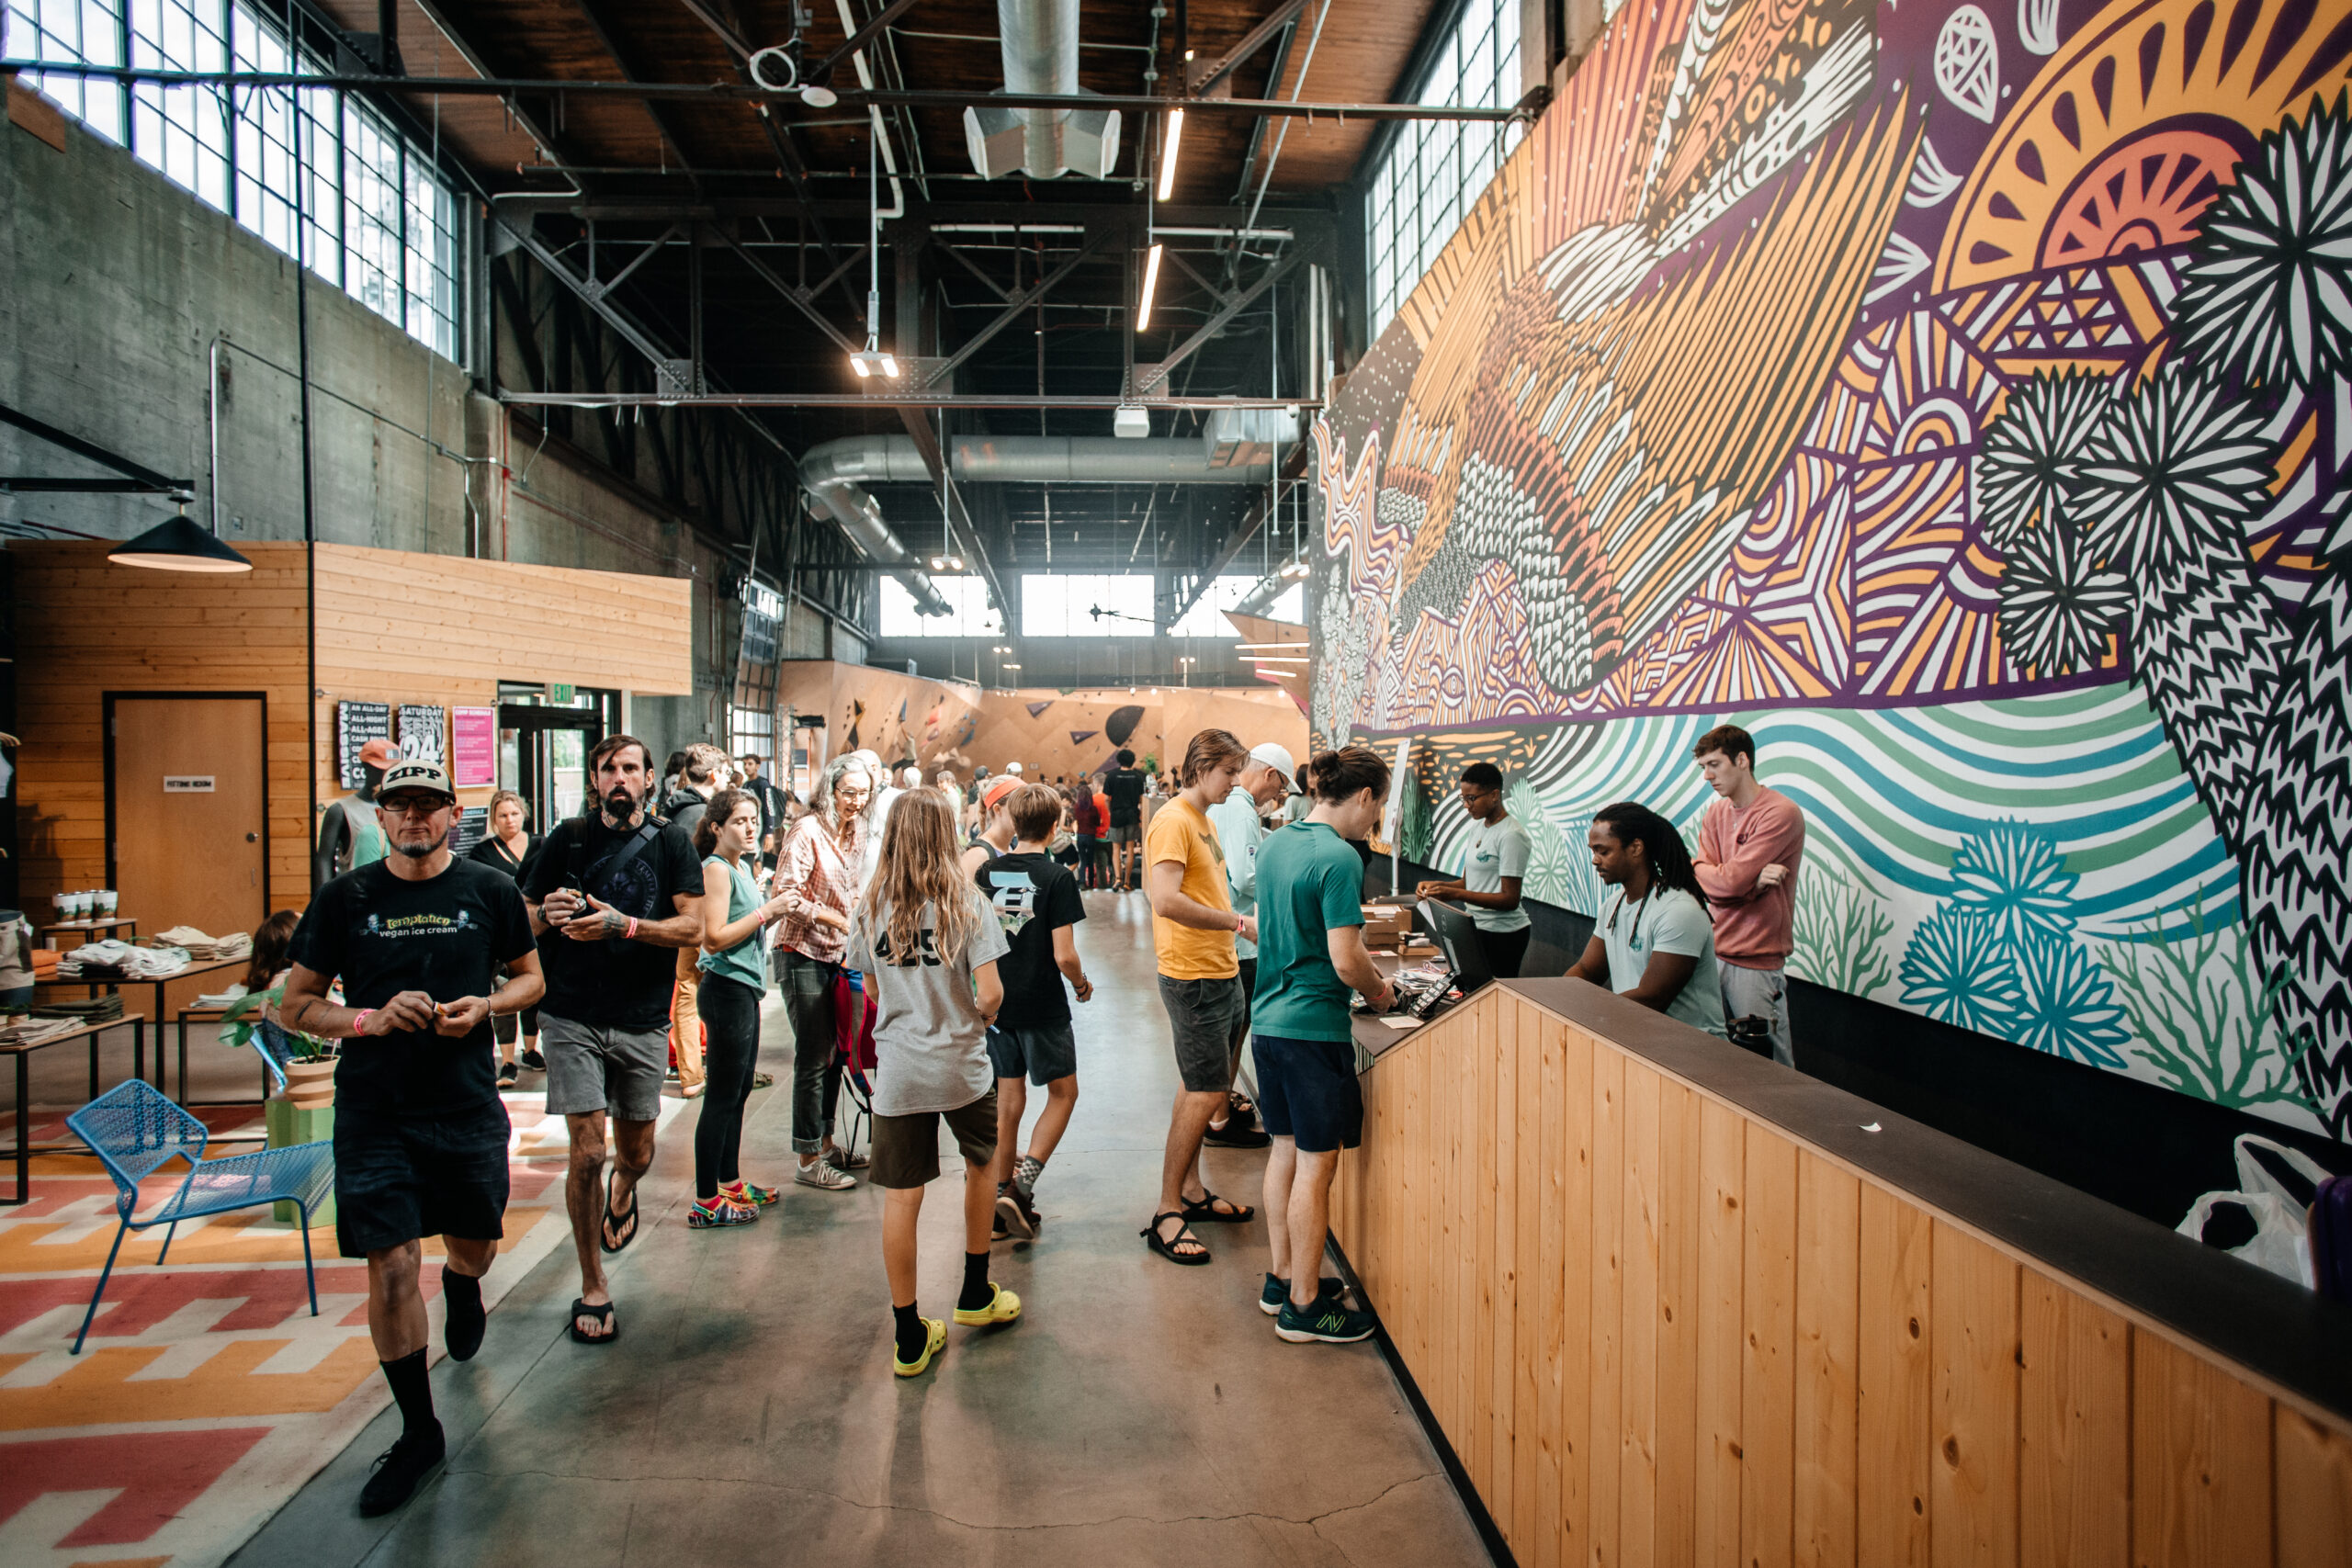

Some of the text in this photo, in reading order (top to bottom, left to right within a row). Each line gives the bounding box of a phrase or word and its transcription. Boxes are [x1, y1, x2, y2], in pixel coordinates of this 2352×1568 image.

[554, 683, 571, 702] EXIT
[401, 705, 443, 716] SATURDAY
[351, 726, 387, 734] ALL-AGES
[339, 703, 350, 788] MASSIVE
[403, 734, 440, 762] 24
[387, 766, 441, 784] ZIPP
[379, 929, 409, 938] vegan
